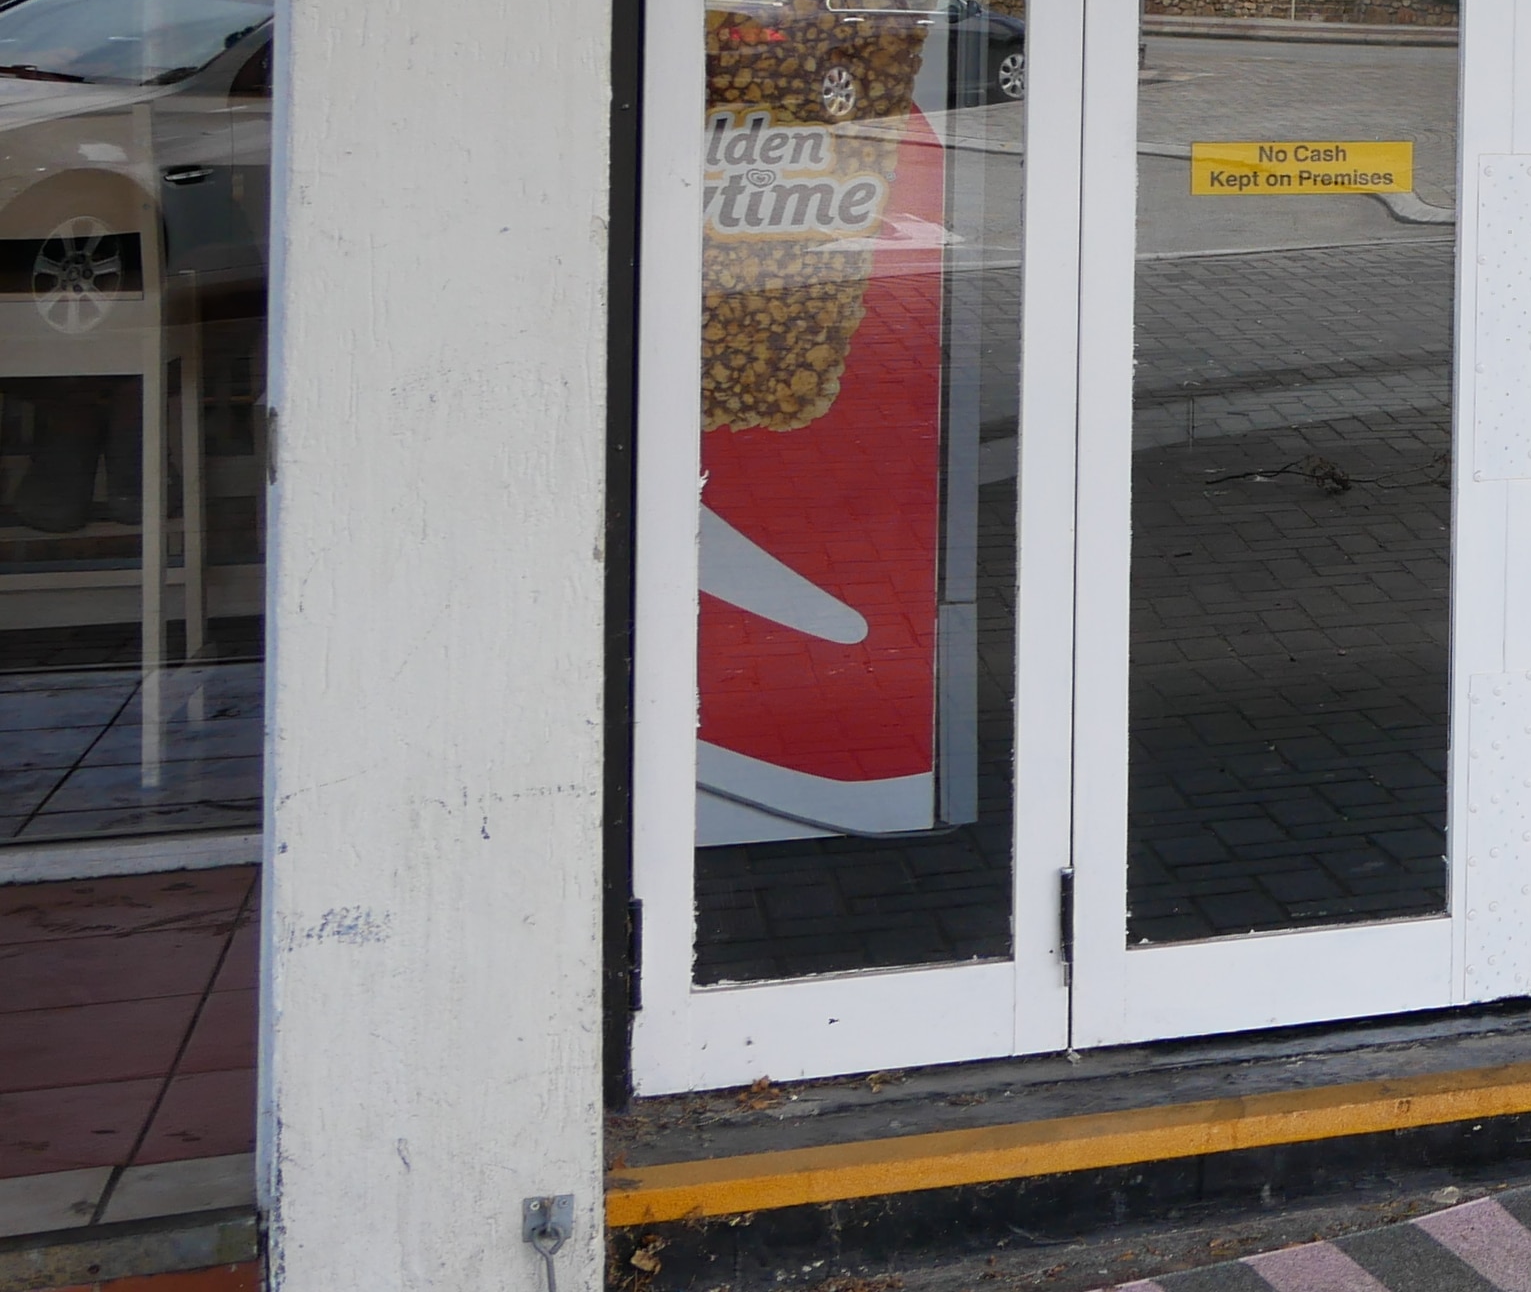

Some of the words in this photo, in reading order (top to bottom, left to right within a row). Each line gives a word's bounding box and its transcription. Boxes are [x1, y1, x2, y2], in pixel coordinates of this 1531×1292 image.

[1258, 145, 1288, 163] No
[1293, 145, 1347, 163] Cash
[1209, 170, 1260, 190] Kept
[1267, 174, 1292, 187] on
[1298, 168, 1394, 187] Premises
